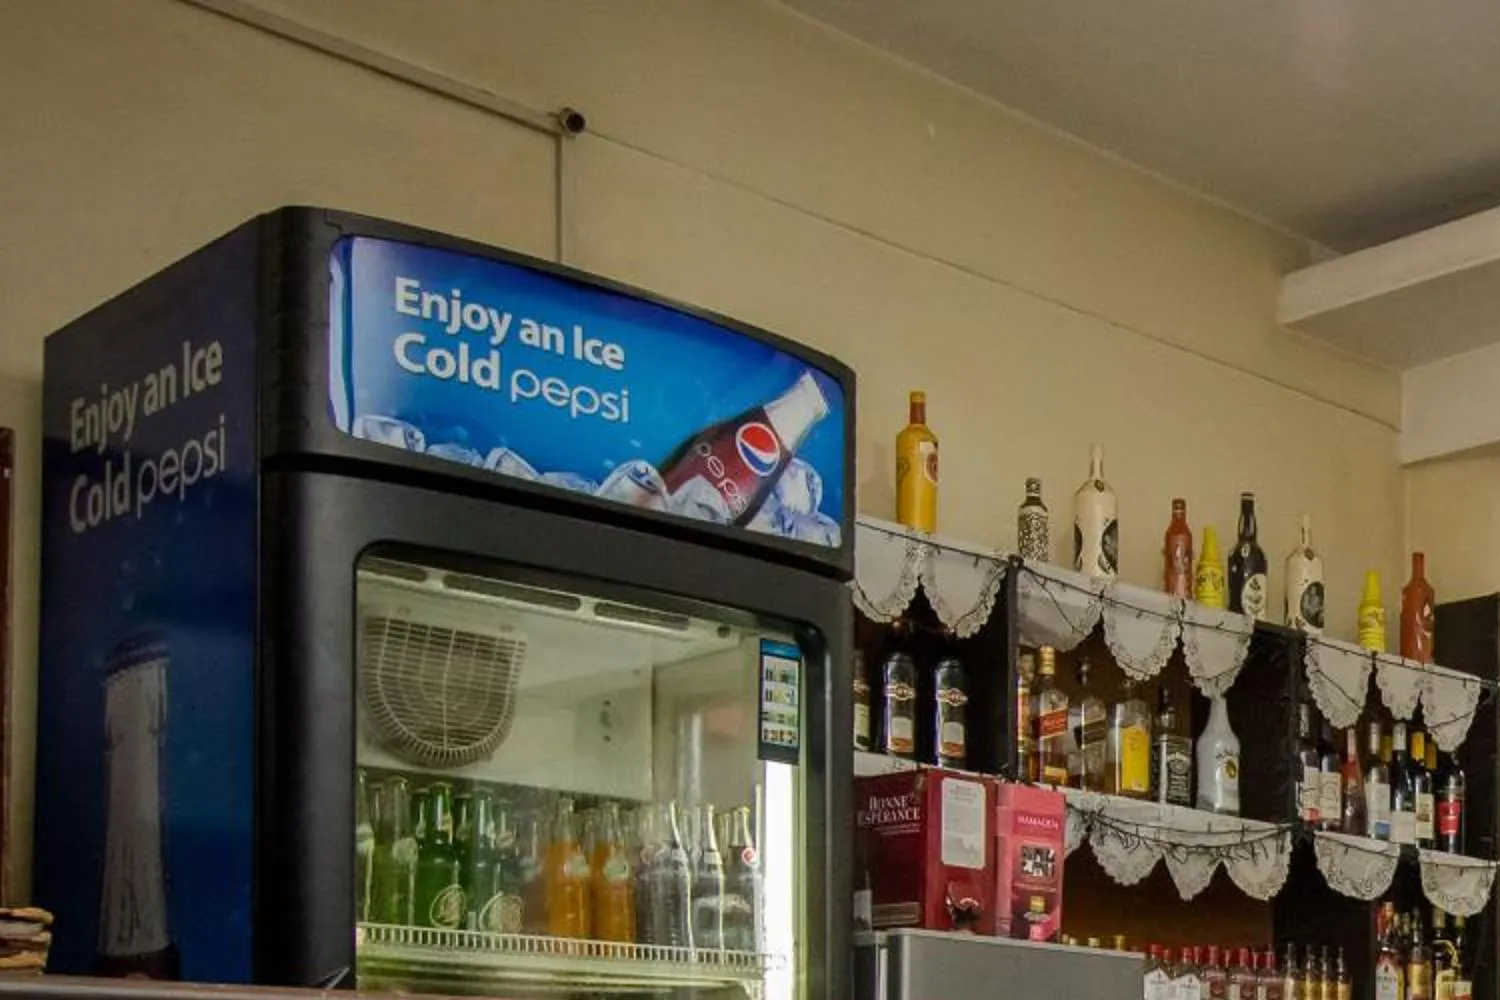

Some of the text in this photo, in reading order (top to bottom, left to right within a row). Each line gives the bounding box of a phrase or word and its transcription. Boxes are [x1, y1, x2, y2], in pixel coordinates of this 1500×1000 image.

[395, 276, 625, 370] Enjoy an Ice
[70, 340, 223, 454] Enjoy an Ice
[393, 332, 629, 423] Cold pepsi
[70, 412, 226, 533] Cold pepsi
